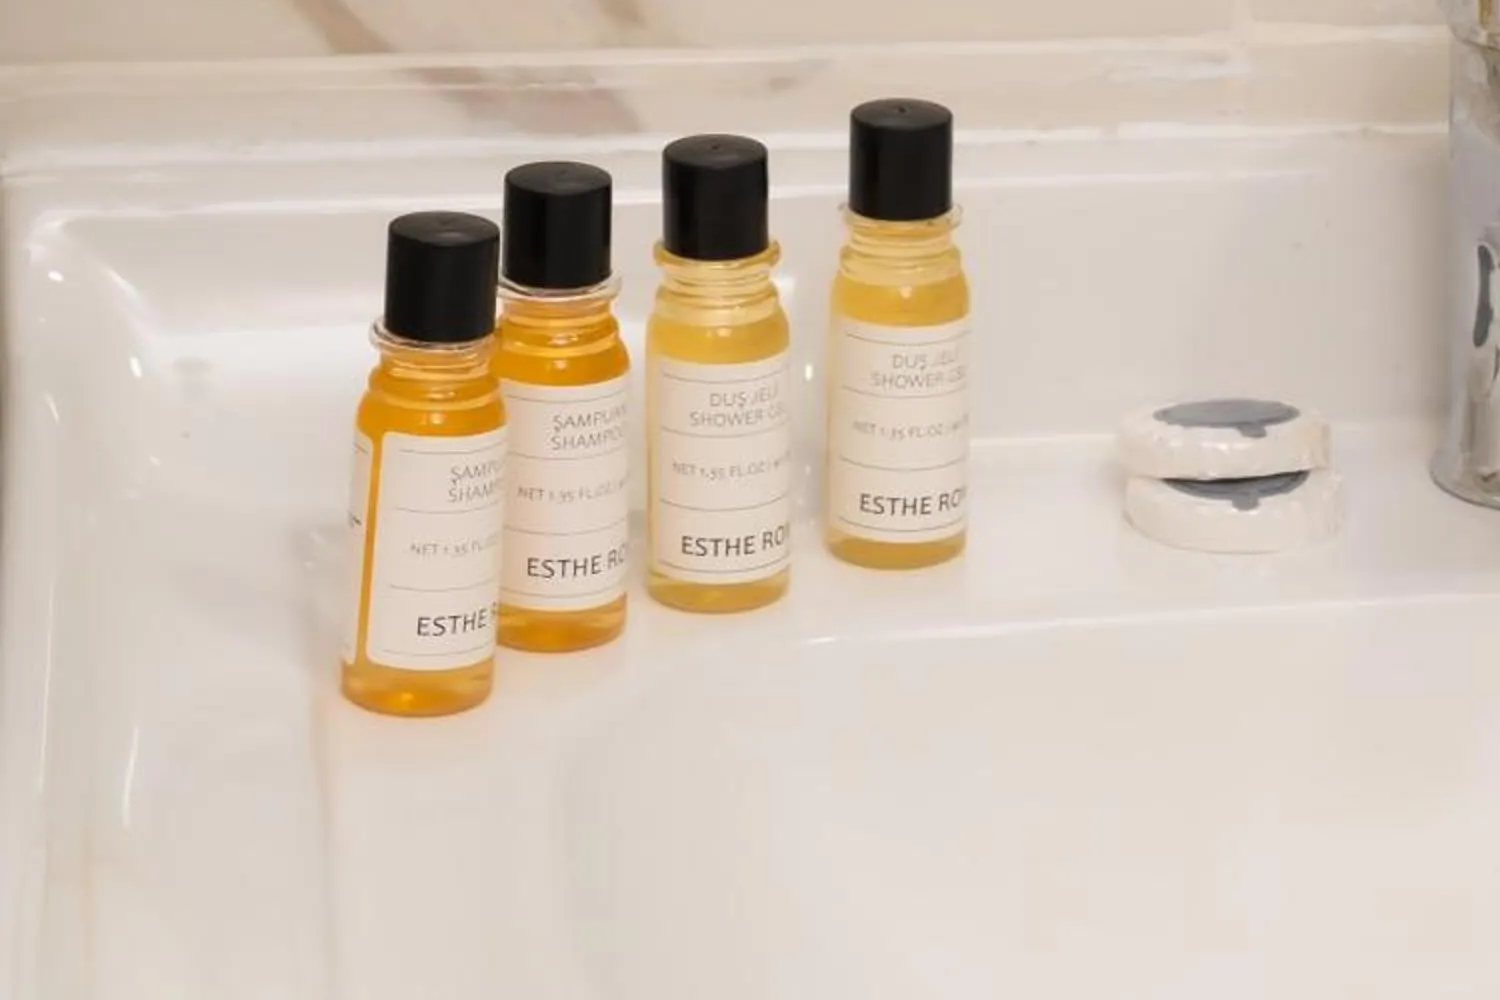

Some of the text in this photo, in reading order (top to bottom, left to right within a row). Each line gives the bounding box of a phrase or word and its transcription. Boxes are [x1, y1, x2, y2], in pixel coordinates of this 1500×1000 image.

[709, 391, 748, 408] DUŞ
[689, 408, 763, 427] SHOWER
[859, 493, 932, 515] ESTHE
[681, 535, 756, 557] ESTHE
[527, 555, 602, 579] ESTHE
[417, 608, 488, 637] ESTHE
